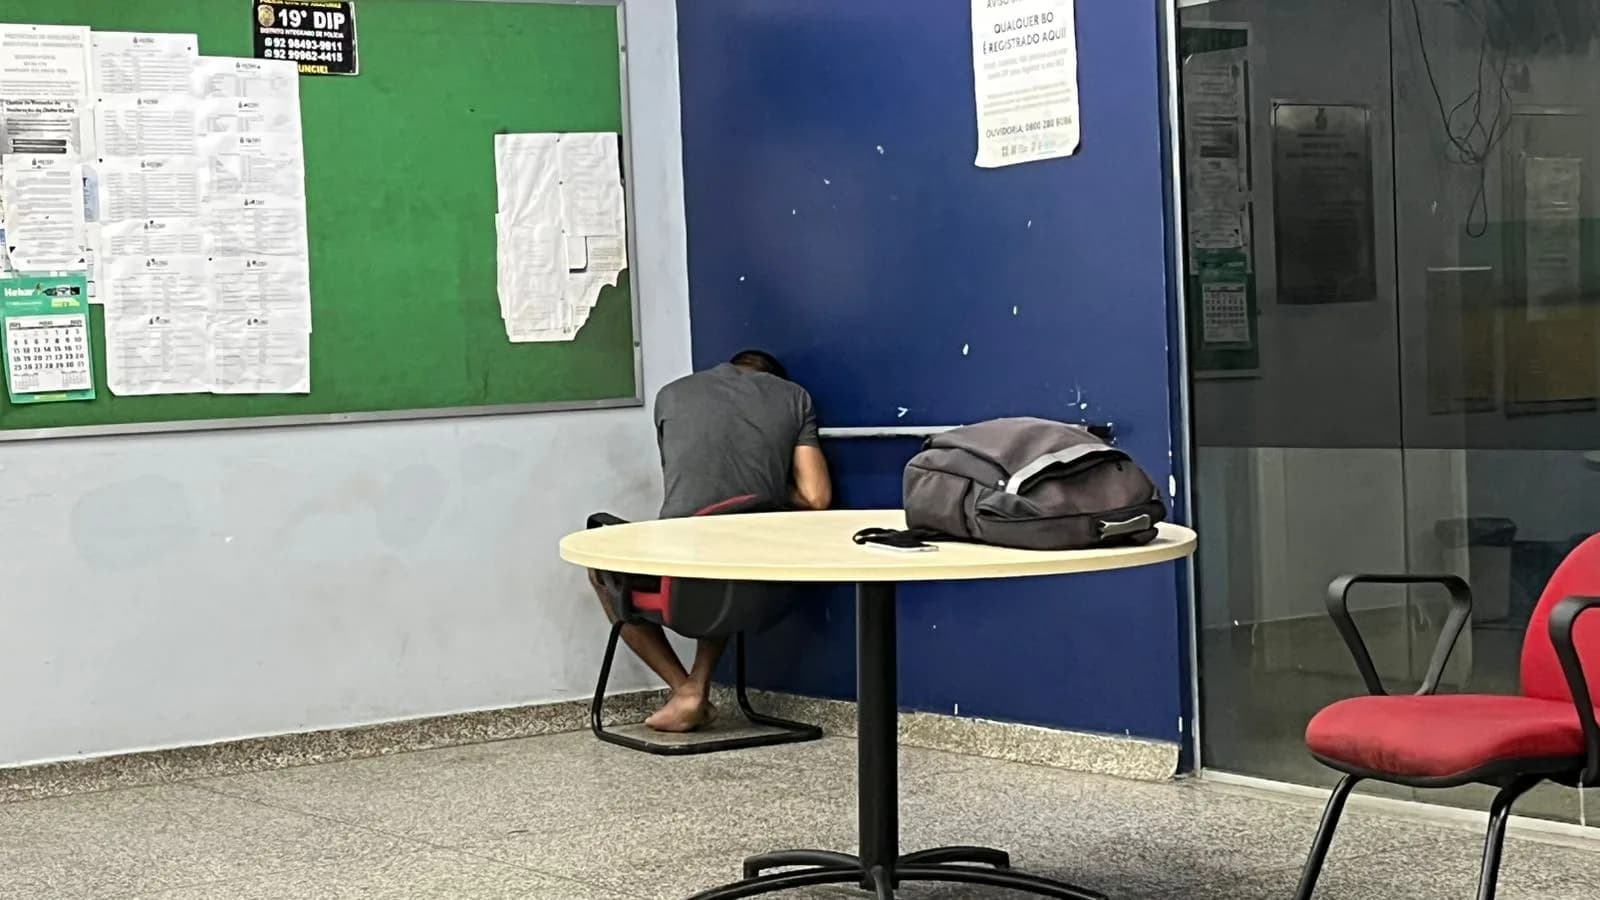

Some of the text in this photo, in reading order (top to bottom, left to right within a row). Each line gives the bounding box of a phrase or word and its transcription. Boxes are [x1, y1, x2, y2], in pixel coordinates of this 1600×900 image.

[313, 11, 345, 29] DIP
[994, 12, 1054, 34] QUALQUER BO
[273, 38, 286, 48] 92
[988, 33, 1040, 53] REGISTRADO
[273, 49, 286, 59] 92
